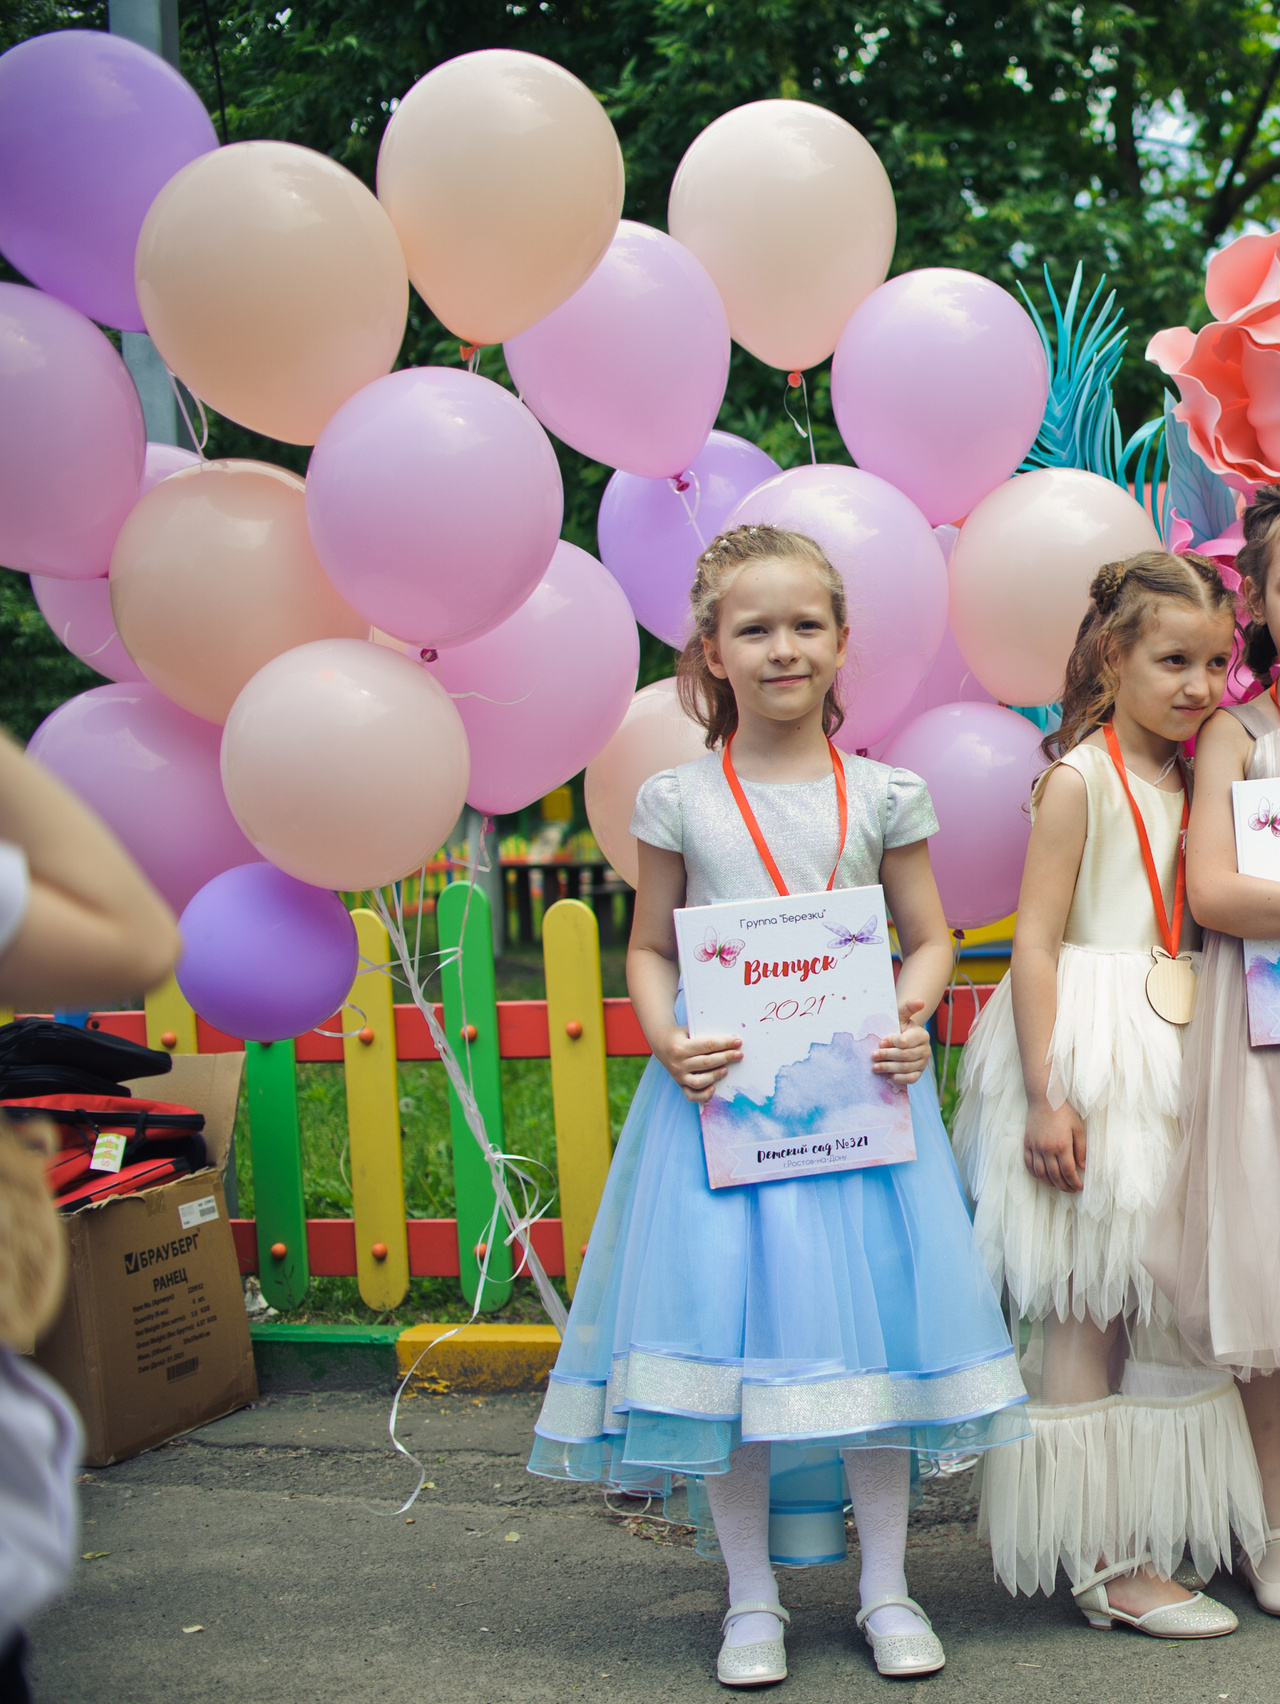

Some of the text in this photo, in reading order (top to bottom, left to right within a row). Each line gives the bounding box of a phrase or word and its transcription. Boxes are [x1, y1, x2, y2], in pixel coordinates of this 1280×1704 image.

[739, 916, 778, 930] Группа
[744, 955, 838, 985] Выпуск
[760, 995, 825, 1022] 2021
[757, 1145, 808, 1163] Детский
[812, 1141, 832, 1156] сад
[140, 1233, 198, 1268] БРАУБЕРГ
[153, 1268, 188, 1292] РАНЕЦ
